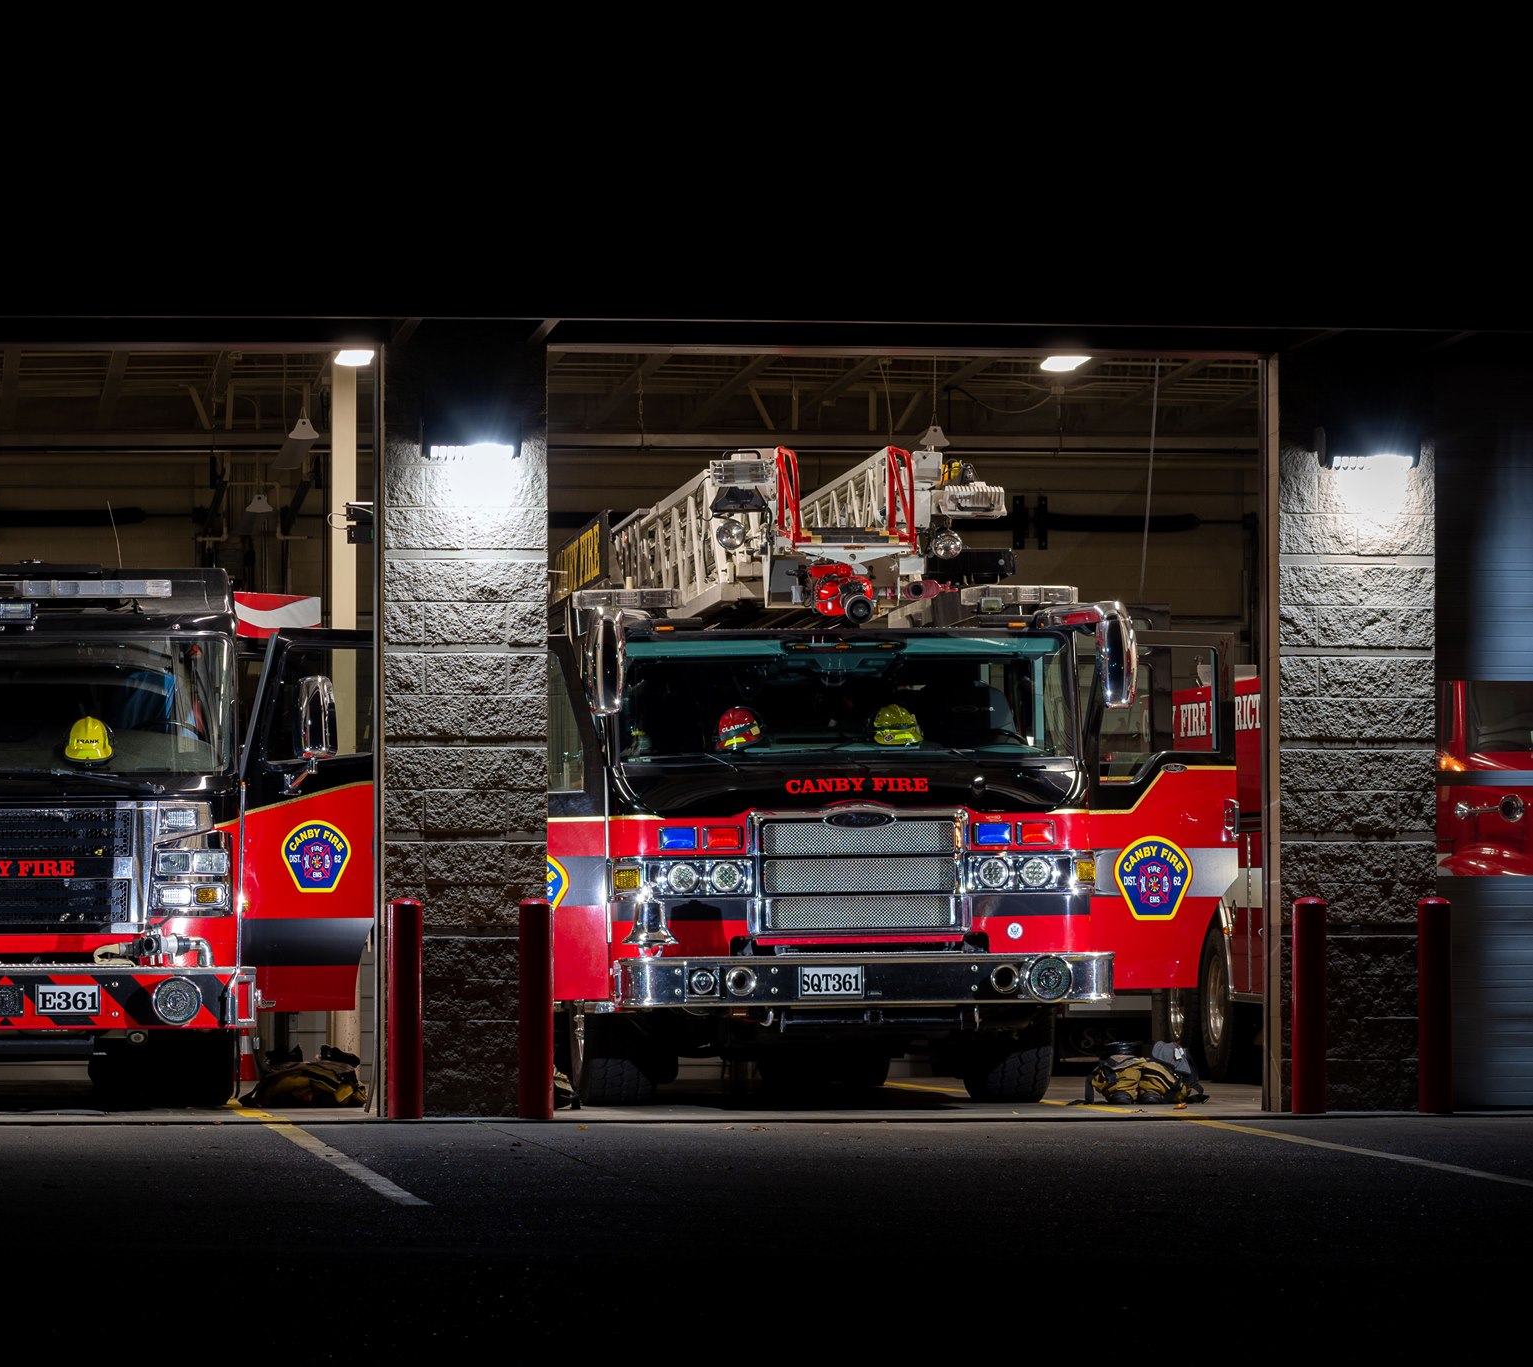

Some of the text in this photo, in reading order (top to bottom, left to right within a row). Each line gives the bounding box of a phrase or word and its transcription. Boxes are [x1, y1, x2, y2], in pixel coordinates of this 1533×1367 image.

[579, 523, 600, 587] FIRE
[1180, 702, 1207, 738] FIRE
[785, 777, 929, 794] CANBY FIRE
[289, 828, 345, 852] CANBY FIRE
[310, 845, 324, 853] FIRE
[288, 854, 342, 863] DIST. 62
[1123, 846, 1185, 873] CANBY FIRE
[18, 860, 75, 877] FIRE
[1147, 865, 1162, 874] FIRE
[1123, 876, 1182, 886] DIST. 62
[802, 973, 860, 992] SQT361
[39, 991, 98, 1011] E361
